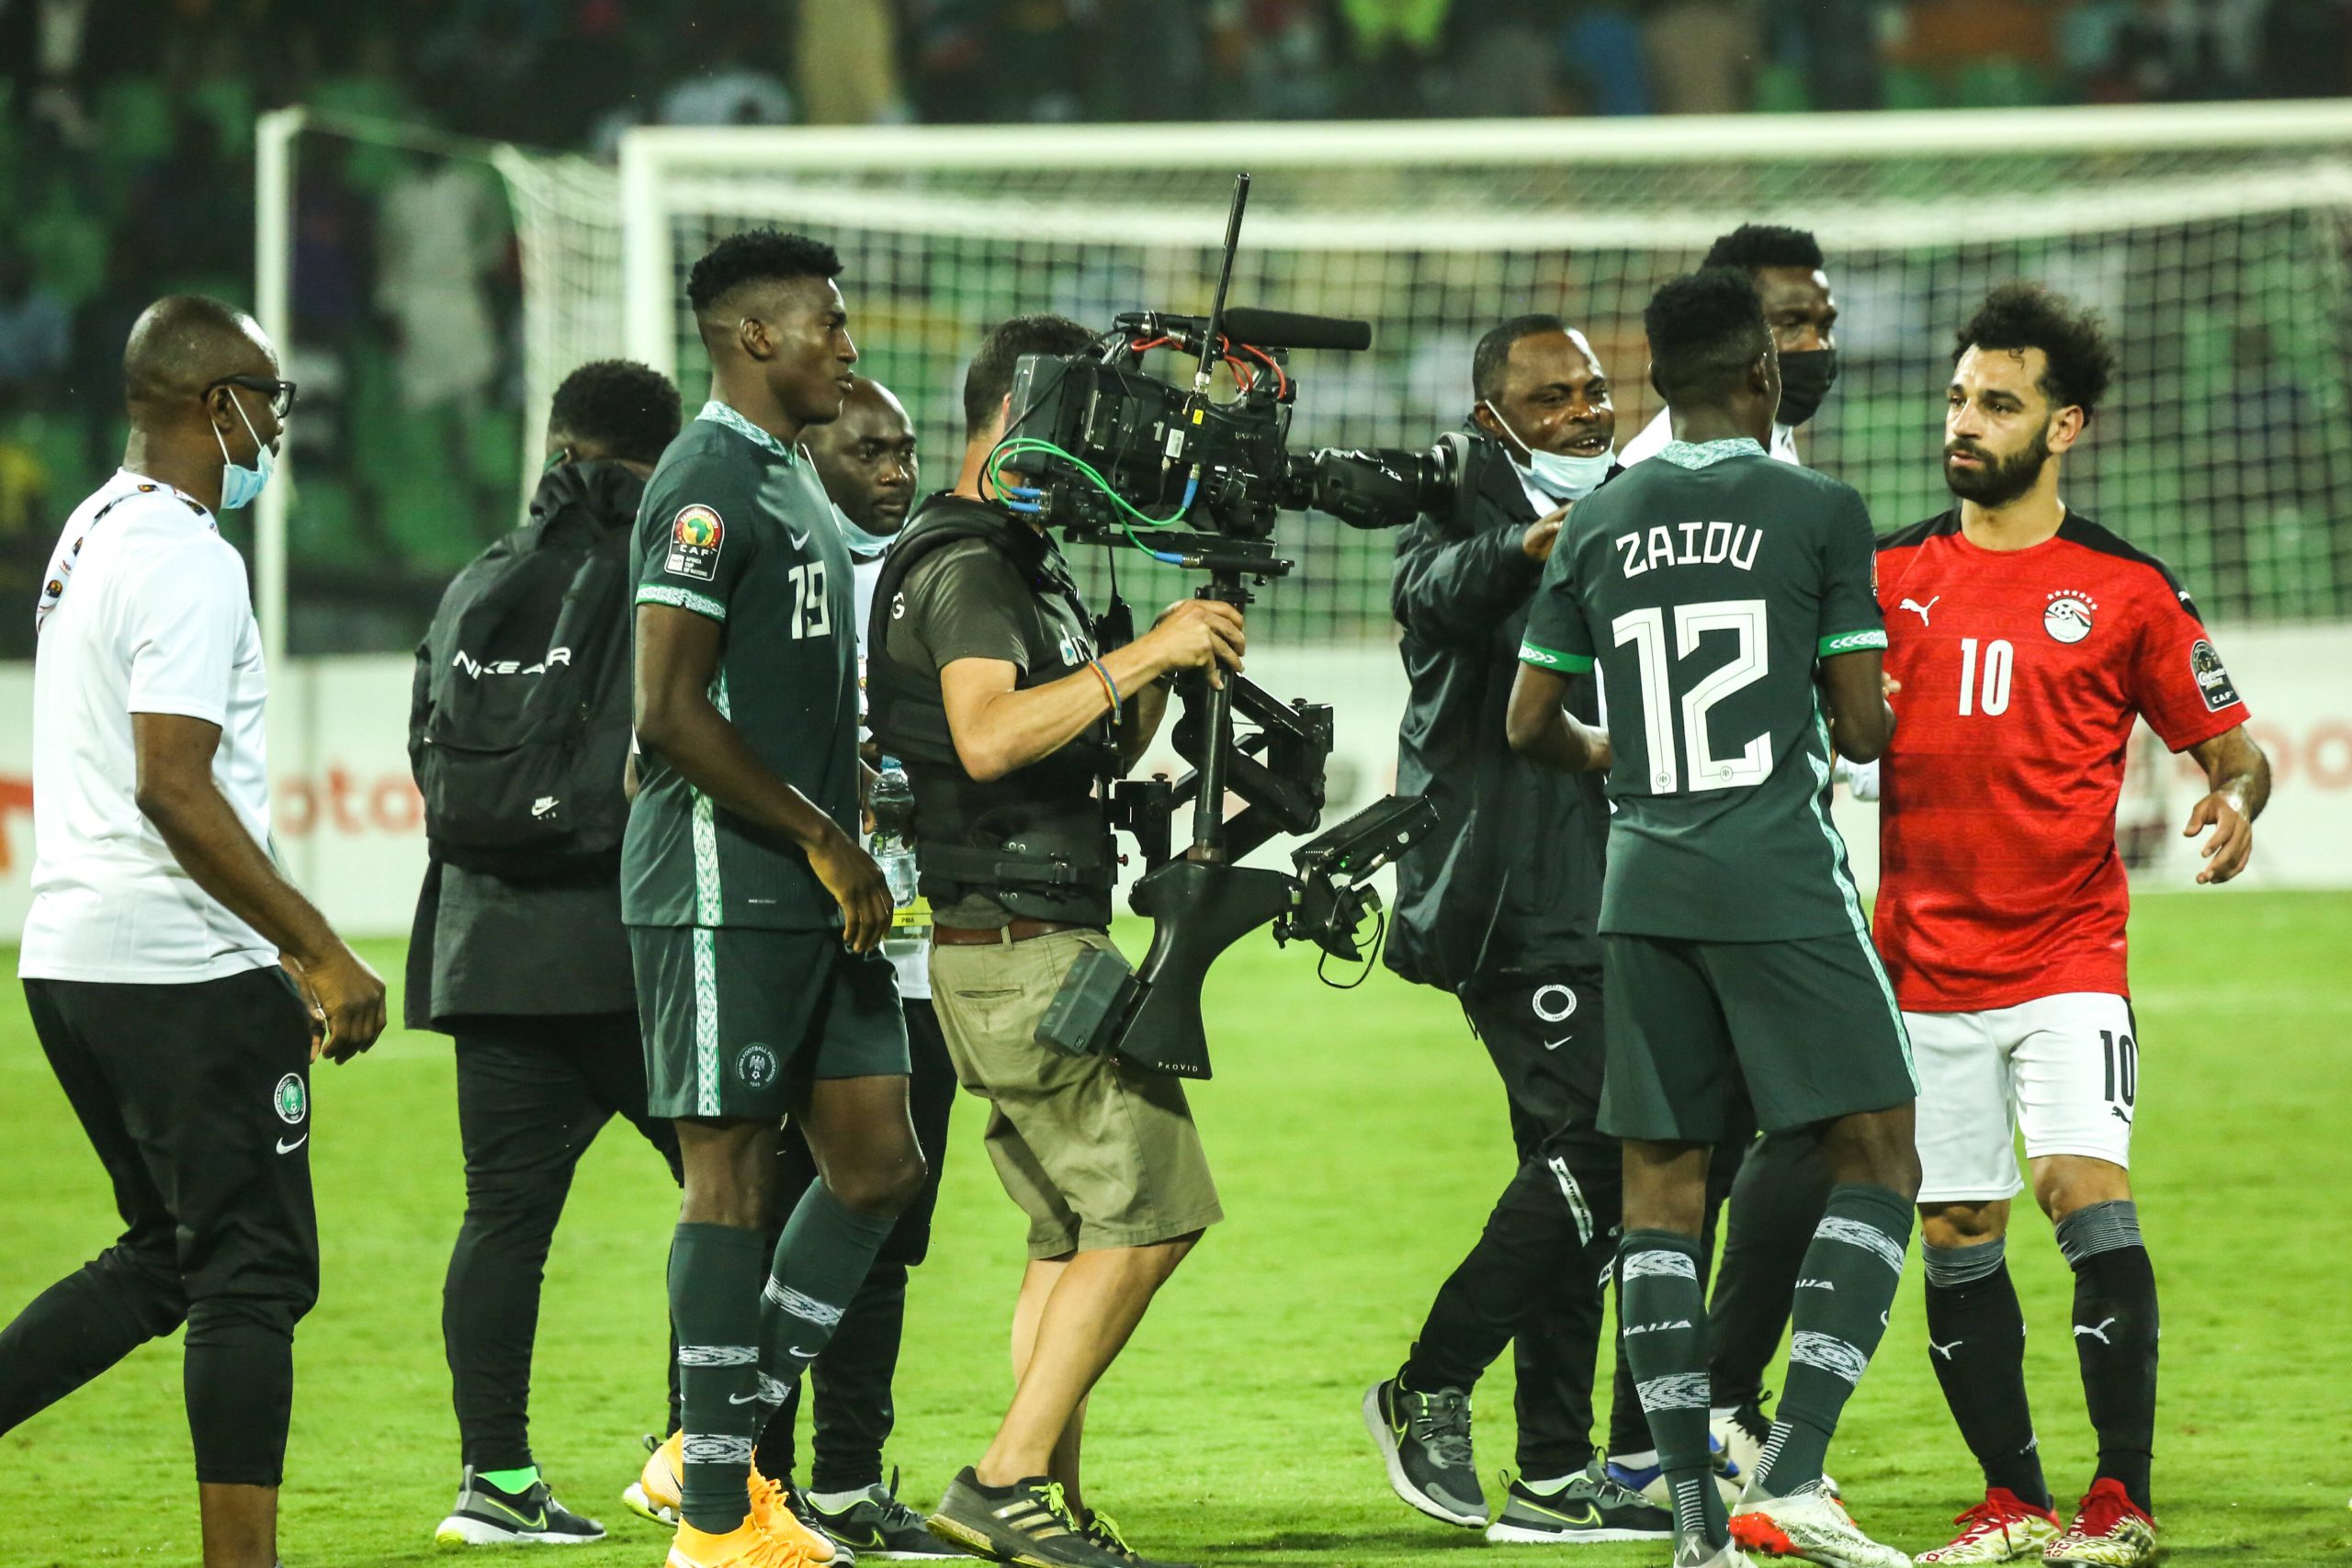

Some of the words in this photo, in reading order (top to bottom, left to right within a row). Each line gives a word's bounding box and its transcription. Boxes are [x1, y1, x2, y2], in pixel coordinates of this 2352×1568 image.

[680, 544, 709, 557] CAF
[1615, 521, 1763, 580] ZAIDU
[788, 560, 831, 639] 19
[1611, 599, 1774, 795] 12
[1958, 637, 2014, 716] 10
[2099, 1030, 2135, 1107] 10
